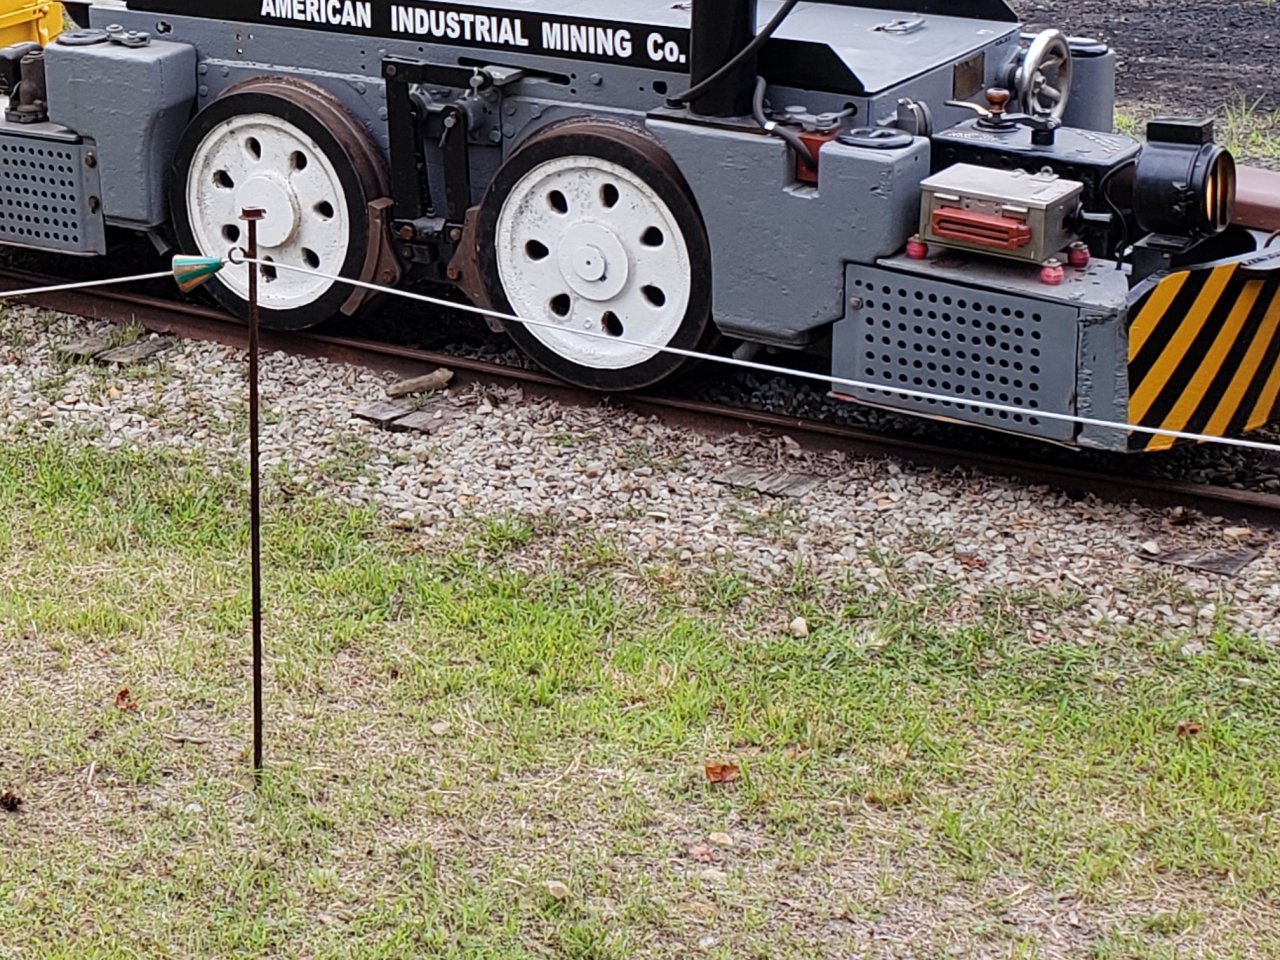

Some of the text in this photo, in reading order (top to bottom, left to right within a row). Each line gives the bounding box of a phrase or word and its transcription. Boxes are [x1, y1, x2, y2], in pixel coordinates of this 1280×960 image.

[389, 4, 530, 47] INDUSTRIAL
[541, 21, 633, 58] MINING
[646, 32, 687, 64] Co.
